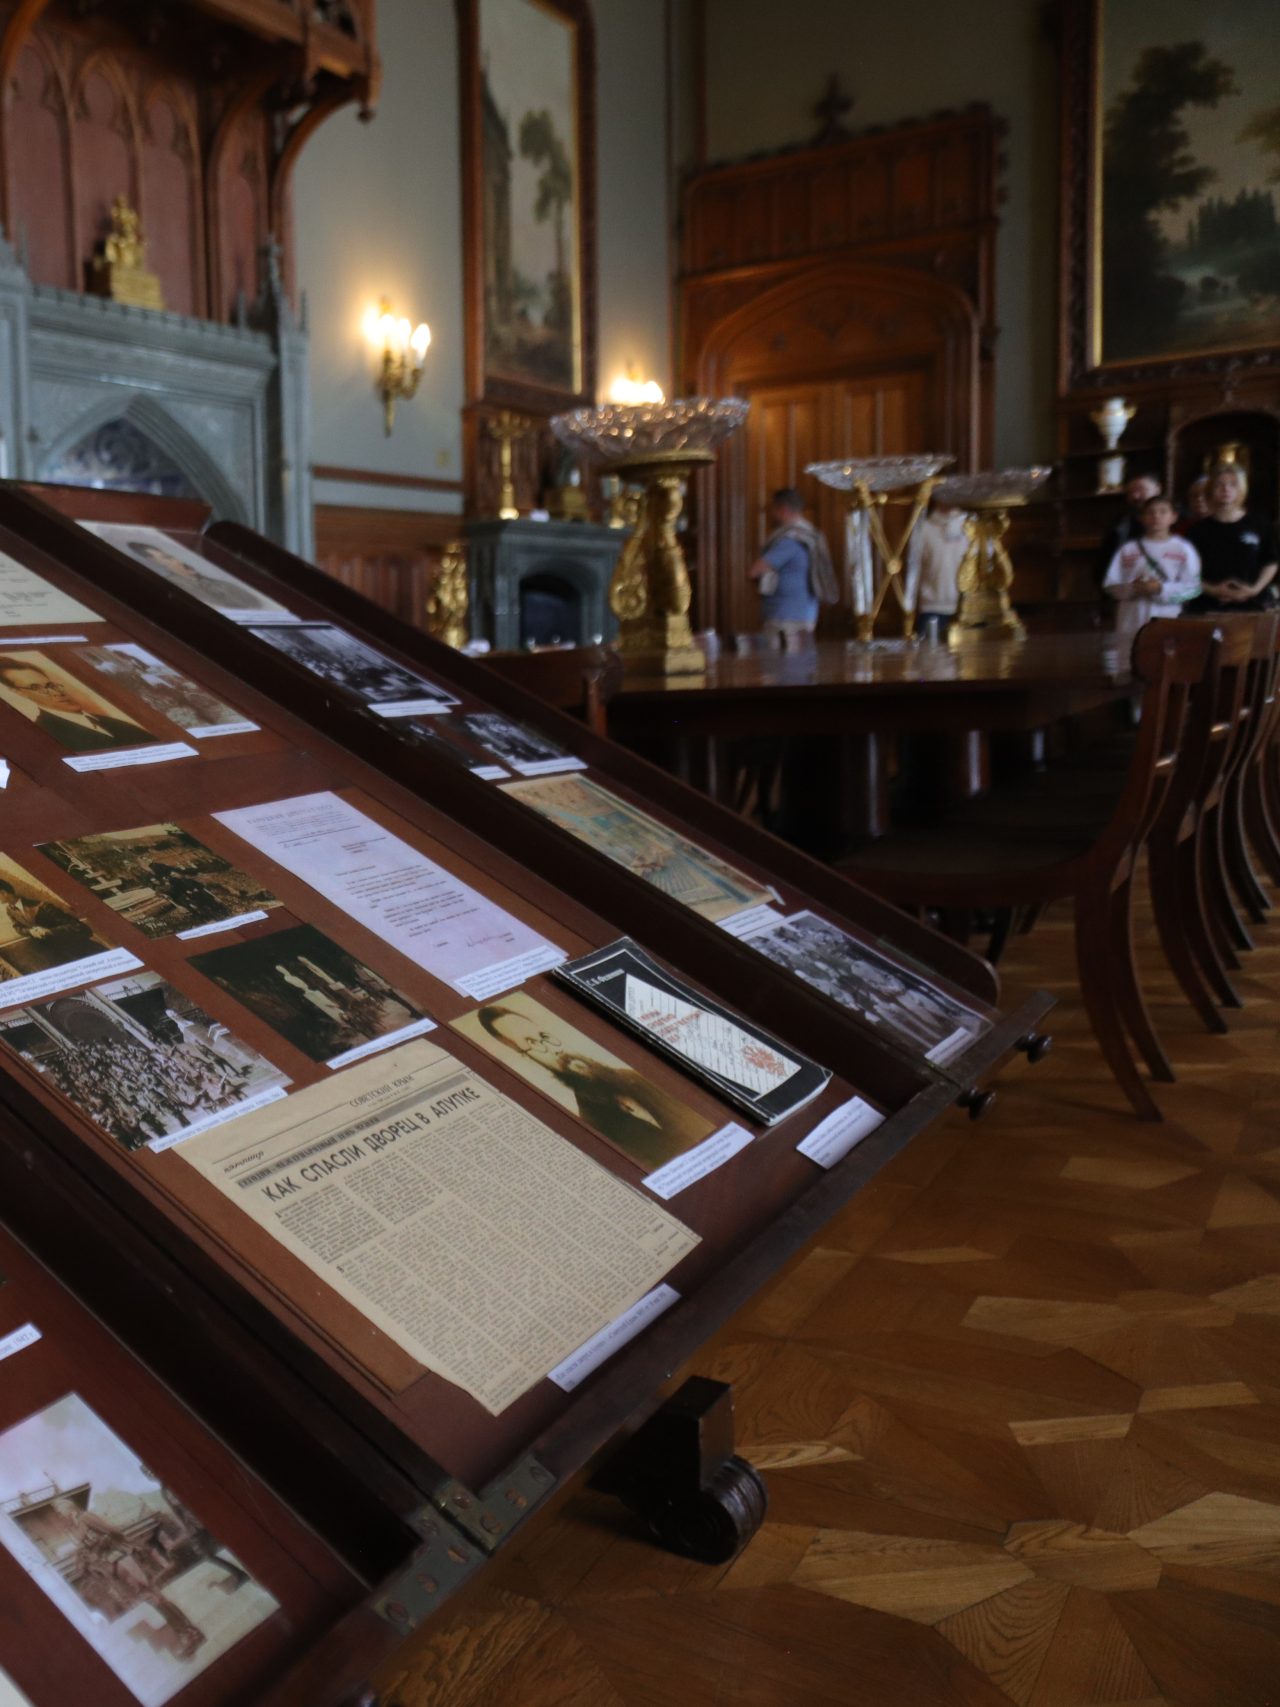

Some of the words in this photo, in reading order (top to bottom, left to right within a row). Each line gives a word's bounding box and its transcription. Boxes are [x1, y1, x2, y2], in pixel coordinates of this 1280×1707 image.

[349, 1083, 393, 1108] СОВЕТСКИЙ
[393, 1074, 415, 1089] КРЫМ
[261, 1176, 303, 1203] КАК
[299, 1143, 367, 1182] СПАСЛИ
[363, 1117, 423, 1153] ДВОРЕЦ
[414, 1111, 431, 1127] В
[429, 1086, 482, 1119] АЛУПКЕ
